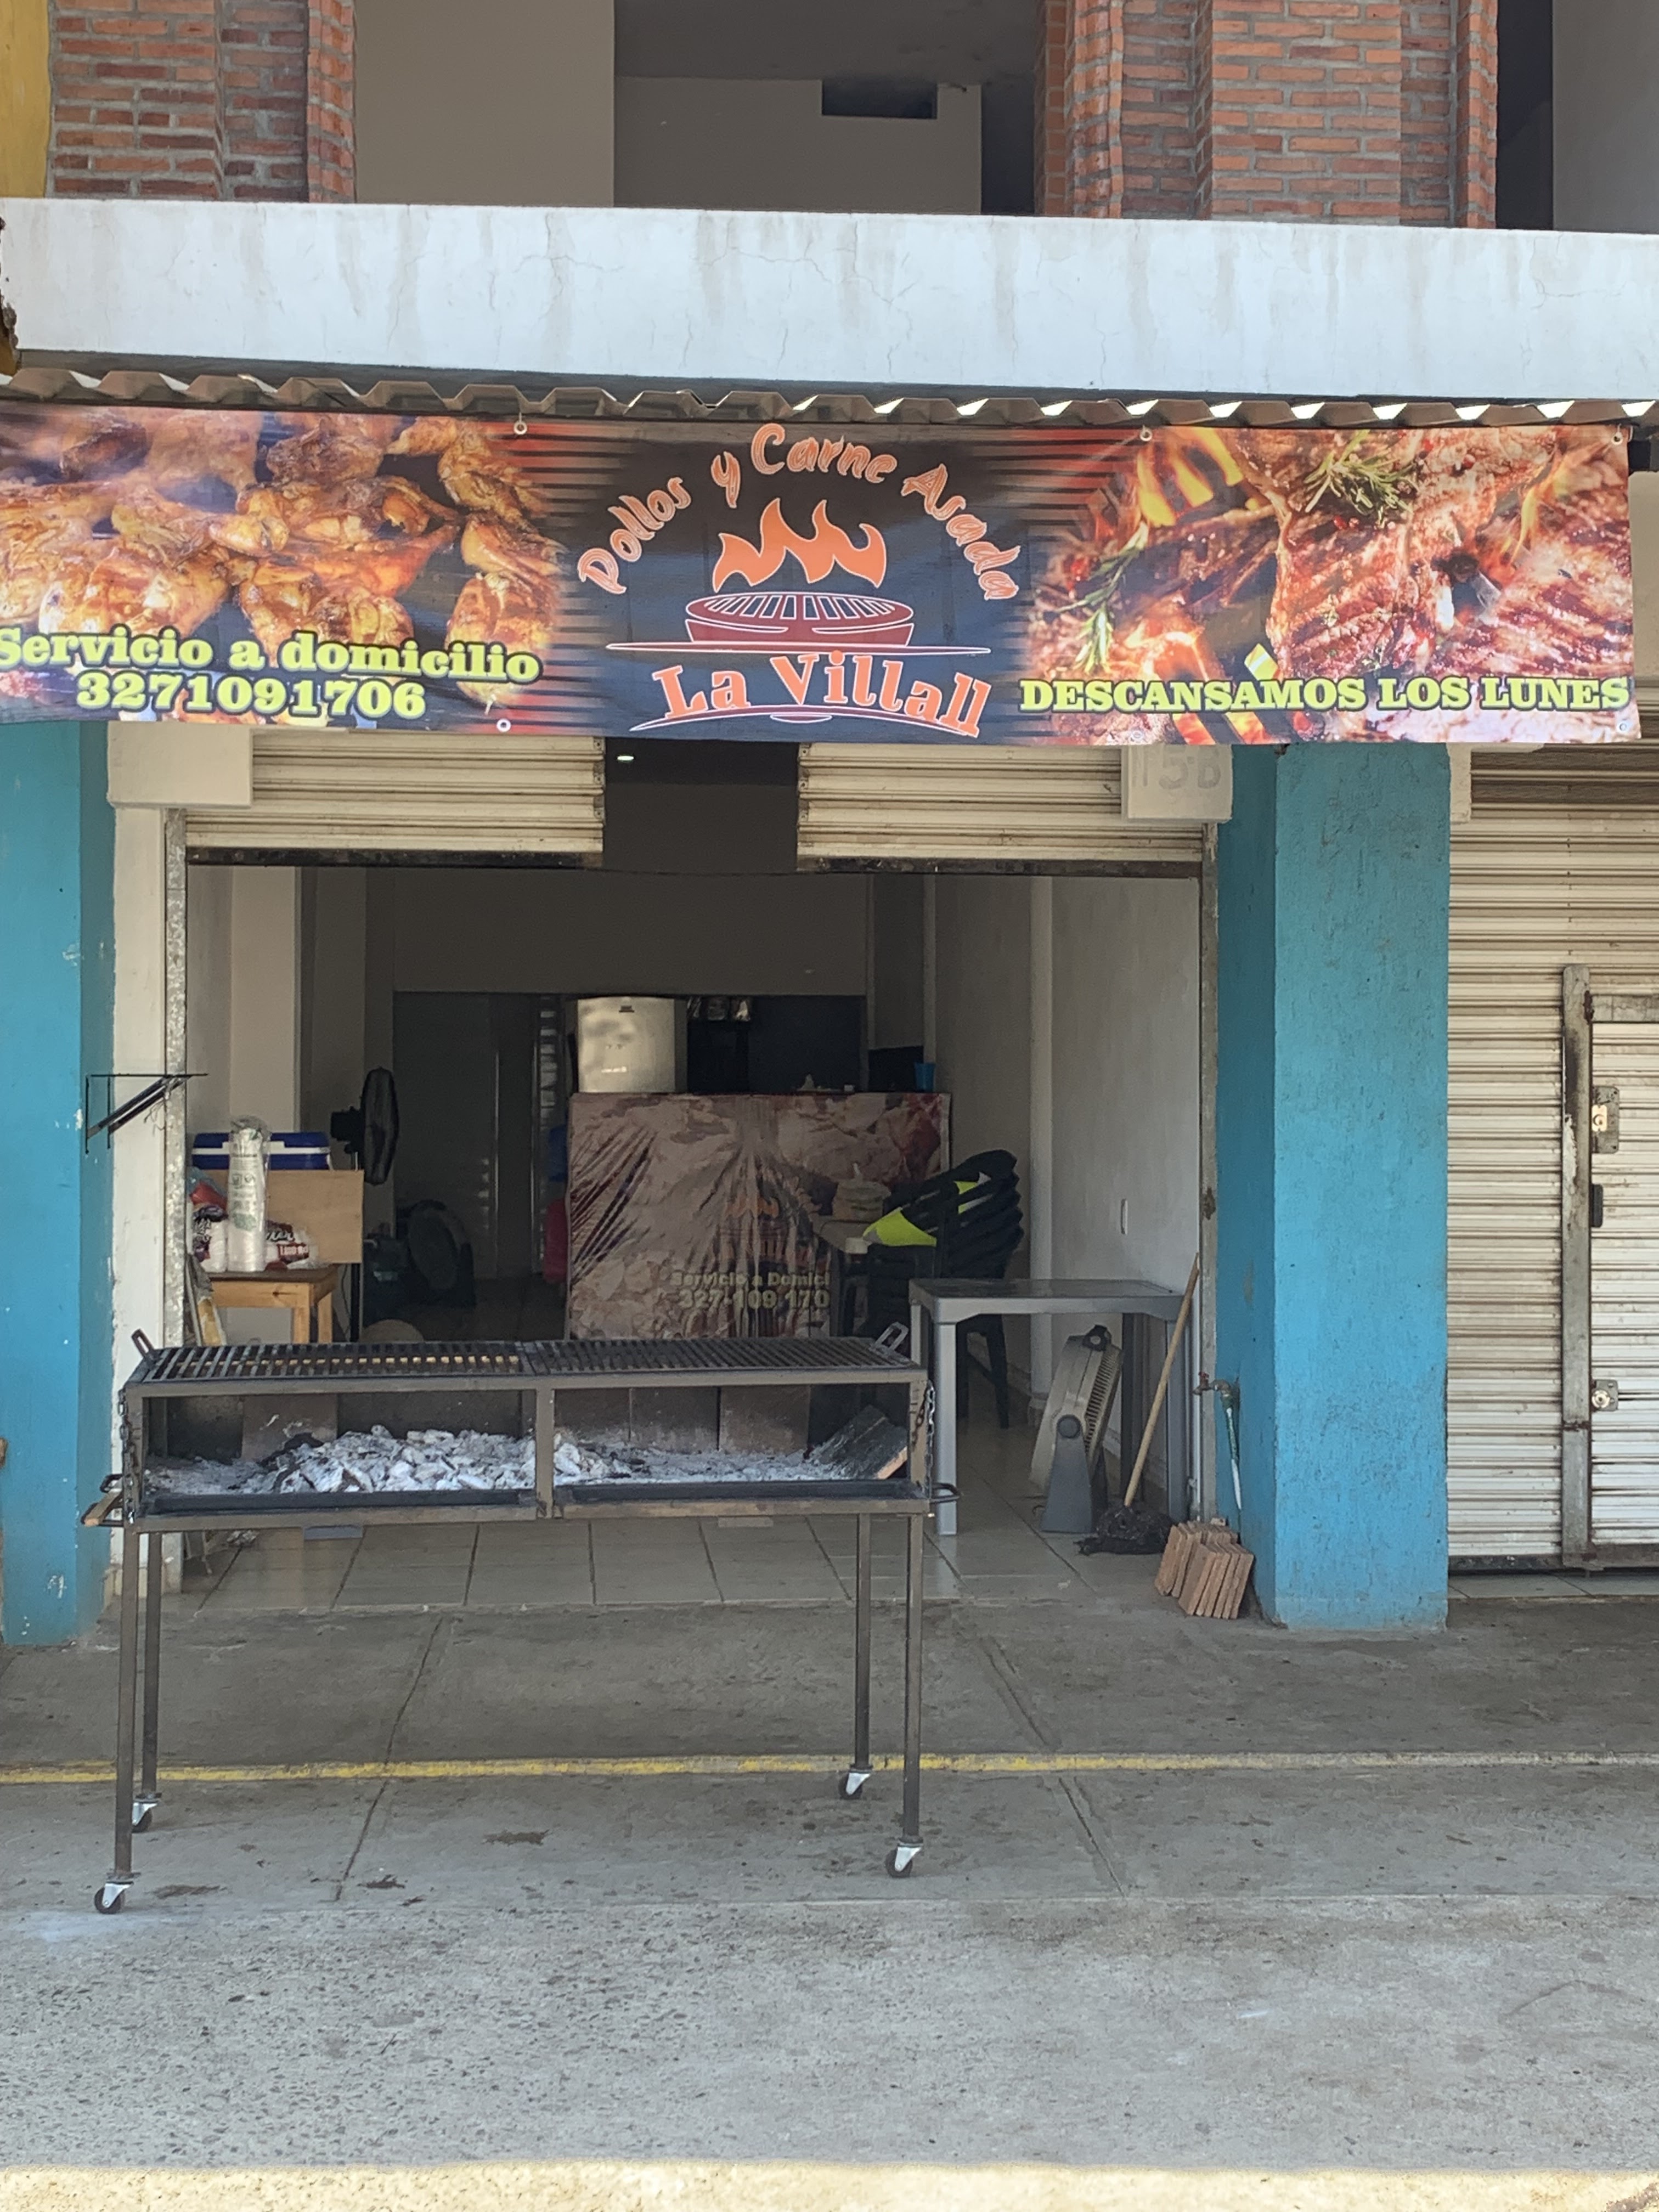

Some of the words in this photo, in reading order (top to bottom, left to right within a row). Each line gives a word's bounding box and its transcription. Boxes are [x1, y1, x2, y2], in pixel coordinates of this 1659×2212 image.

[578, 476, 692, 594] Pollos
[711, 450, 741, 508] y
[751, 422, 898, 483] Carne
[901, 463, 1021, 600] Asada
[0, 627, 213, 668] Servicio
[229, 640, 264, 669] a
[283, 632, 542, 681] domicilio
[76, 670, 426, 718] 3271091706
[652, 664, 752, 719] La
[1019, 678, 1366, 712] DESCANSAMOS
[1377, 676, 1470, 710] LOS
[1481, 676, 1629, 710] LUNES
